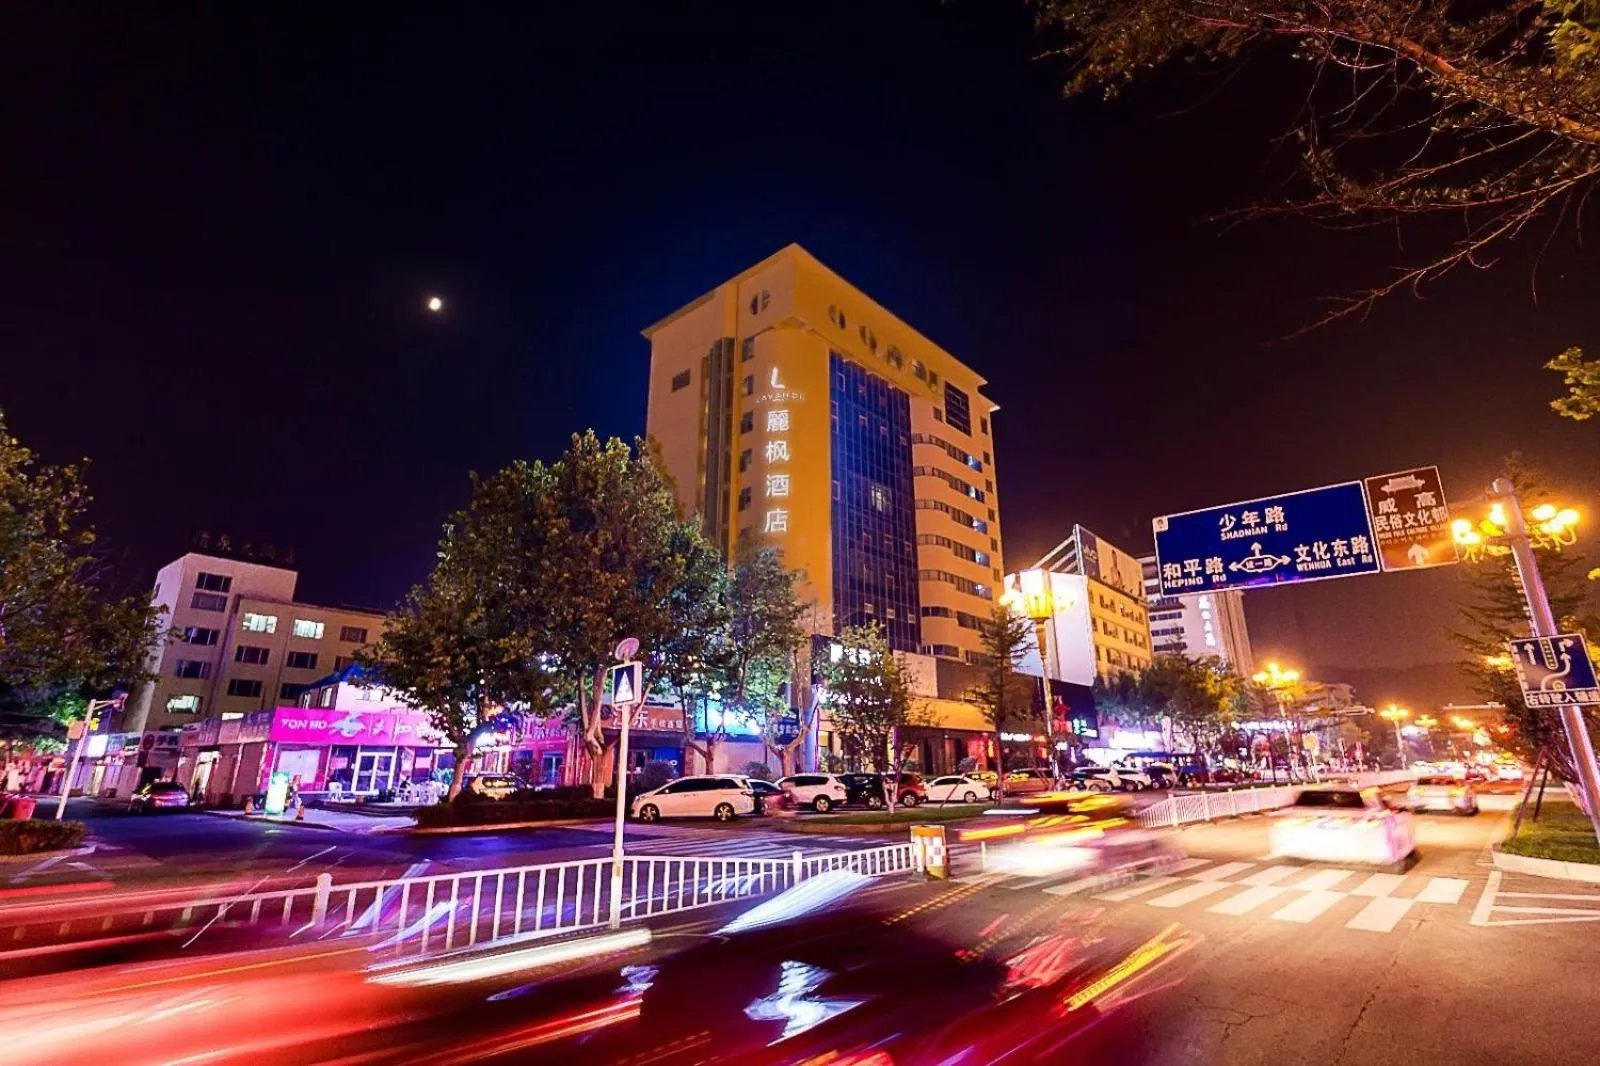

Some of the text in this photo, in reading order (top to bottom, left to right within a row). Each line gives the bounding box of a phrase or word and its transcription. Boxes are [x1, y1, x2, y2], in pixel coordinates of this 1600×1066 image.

[1219, 505, 1286, 532] 少年路
[1275, 522, 1289, 533] Rd
[1294, 534, 1370, 563] 文化东路
[1163, 556, 1224, 580] 和平路
[1337, 555, 1356, 567] East
[1362, 553, 1374, 564] Rd
[1164, 573, 1227, 590] HEPING Rd
